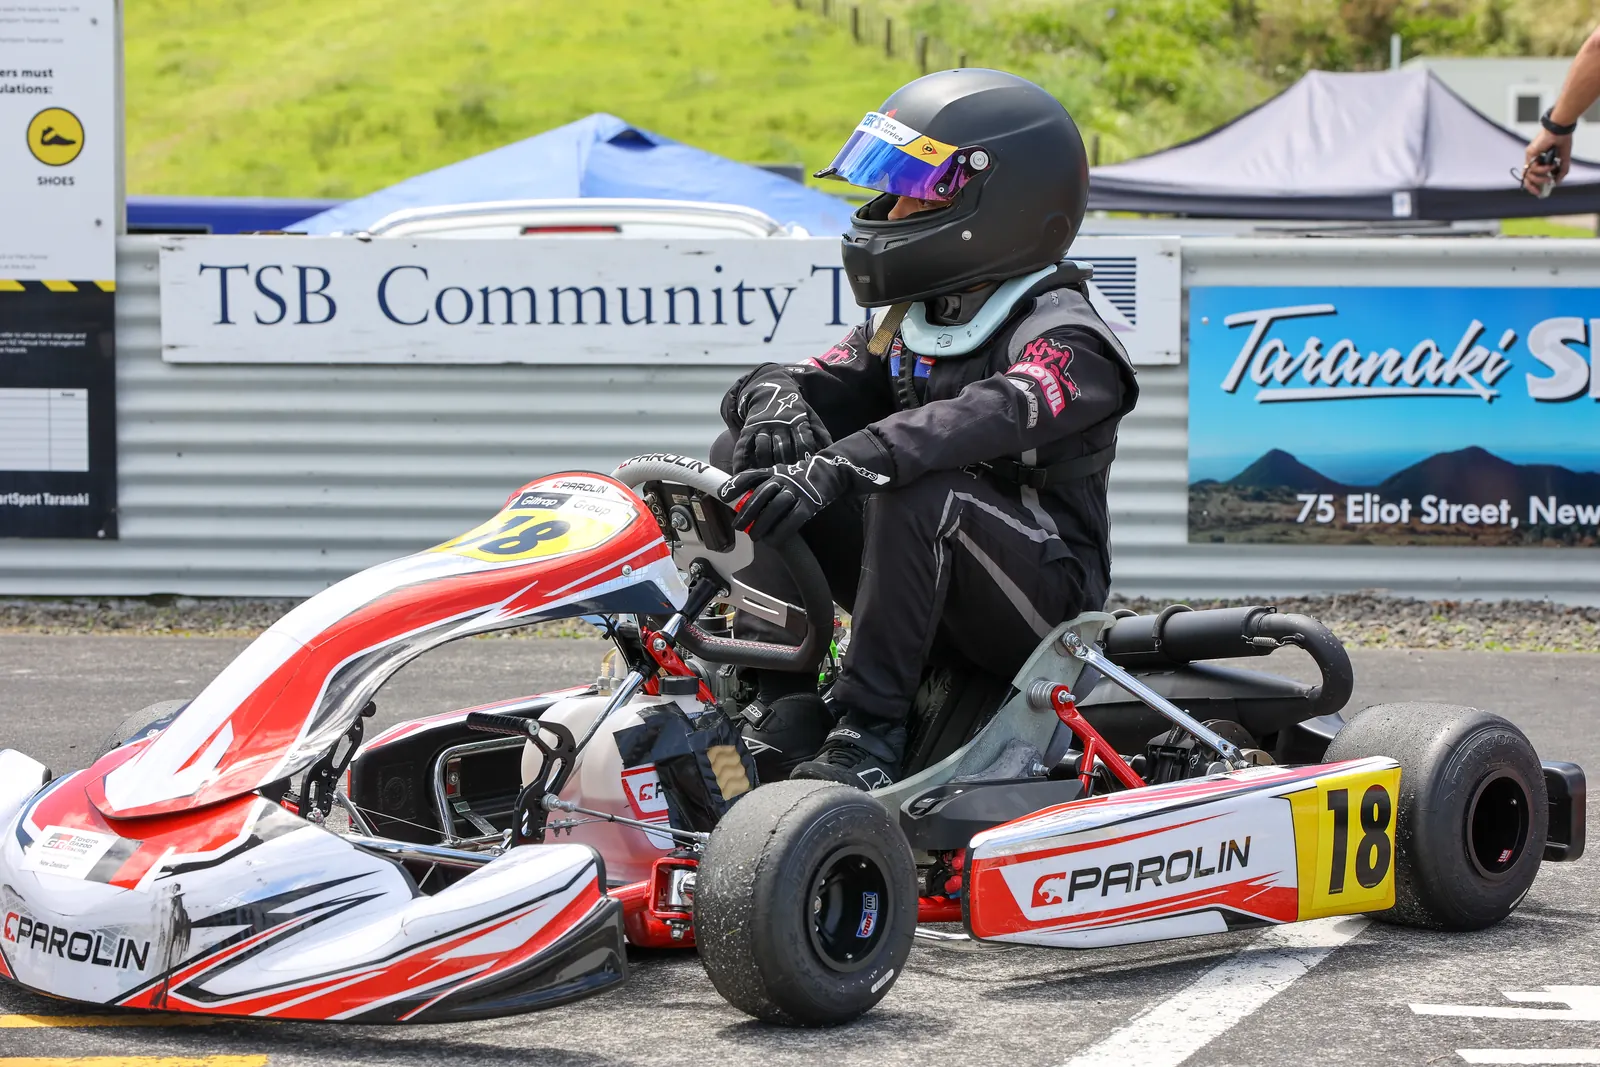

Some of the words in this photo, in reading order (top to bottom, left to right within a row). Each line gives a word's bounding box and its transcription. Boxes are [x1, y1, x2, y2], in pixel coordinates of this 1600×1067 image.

[21, 68, 53, 78] must
[884, 121, 897, 131] tyre
[880, 127, 903, 142] service
[37, 176, 75, 187] SHOES
[199, 263, 338, 327] TSB
[376, 263, 797, 342] Community
[1220, 303, 1517, 403] Taranaki
[1008, 363, 1063, 413] MOTUL
[43, 492, 90, 507] Taranaki
[573, 499, 611, 516] Group
[1296, 494, 1336, 524] 75
[1347, 492, 1412, 525] Eliot
[1420, 494, 1519, 530] Street,
[1529, 495, 1600, 526] New
[452, 515, 571, 555] 18
[69, 841, 93, 849] GAZOO
[74, 836, 99, 845] TOYOTA
[1327, 784, 1392, 895] 18
[64, 846, 87, 855] Racing
